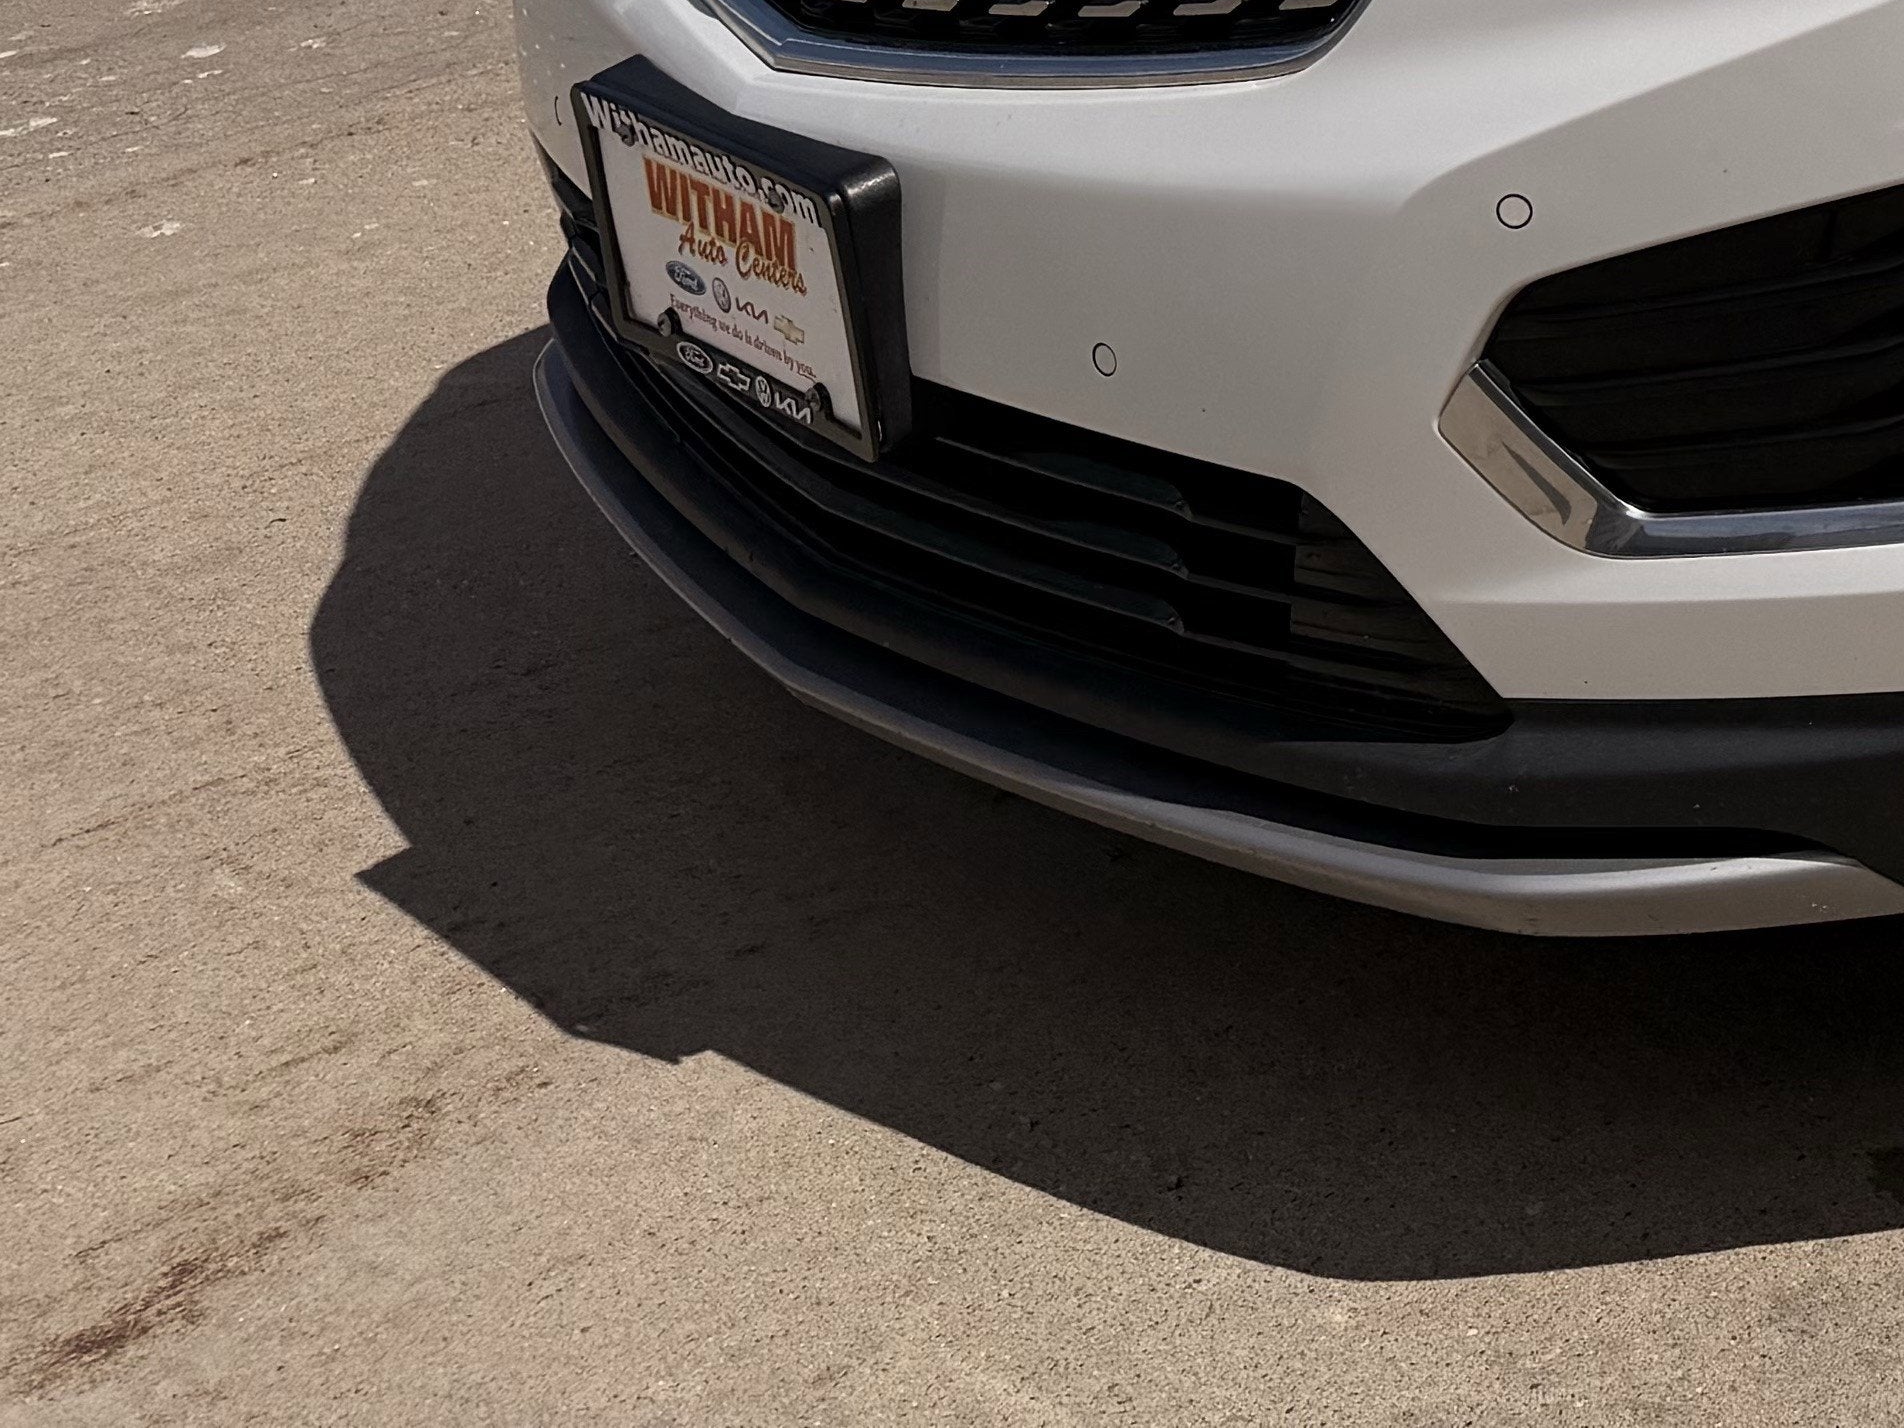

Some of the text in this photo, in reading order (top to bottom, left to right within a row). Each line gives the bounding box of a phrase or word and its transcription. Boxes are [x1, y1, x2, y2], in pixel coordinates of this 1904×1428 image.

[642, 154, 797, 272] WITHAM
[678, 221, 728, 266] Auto
[735, 237, 808, 297] Centers
